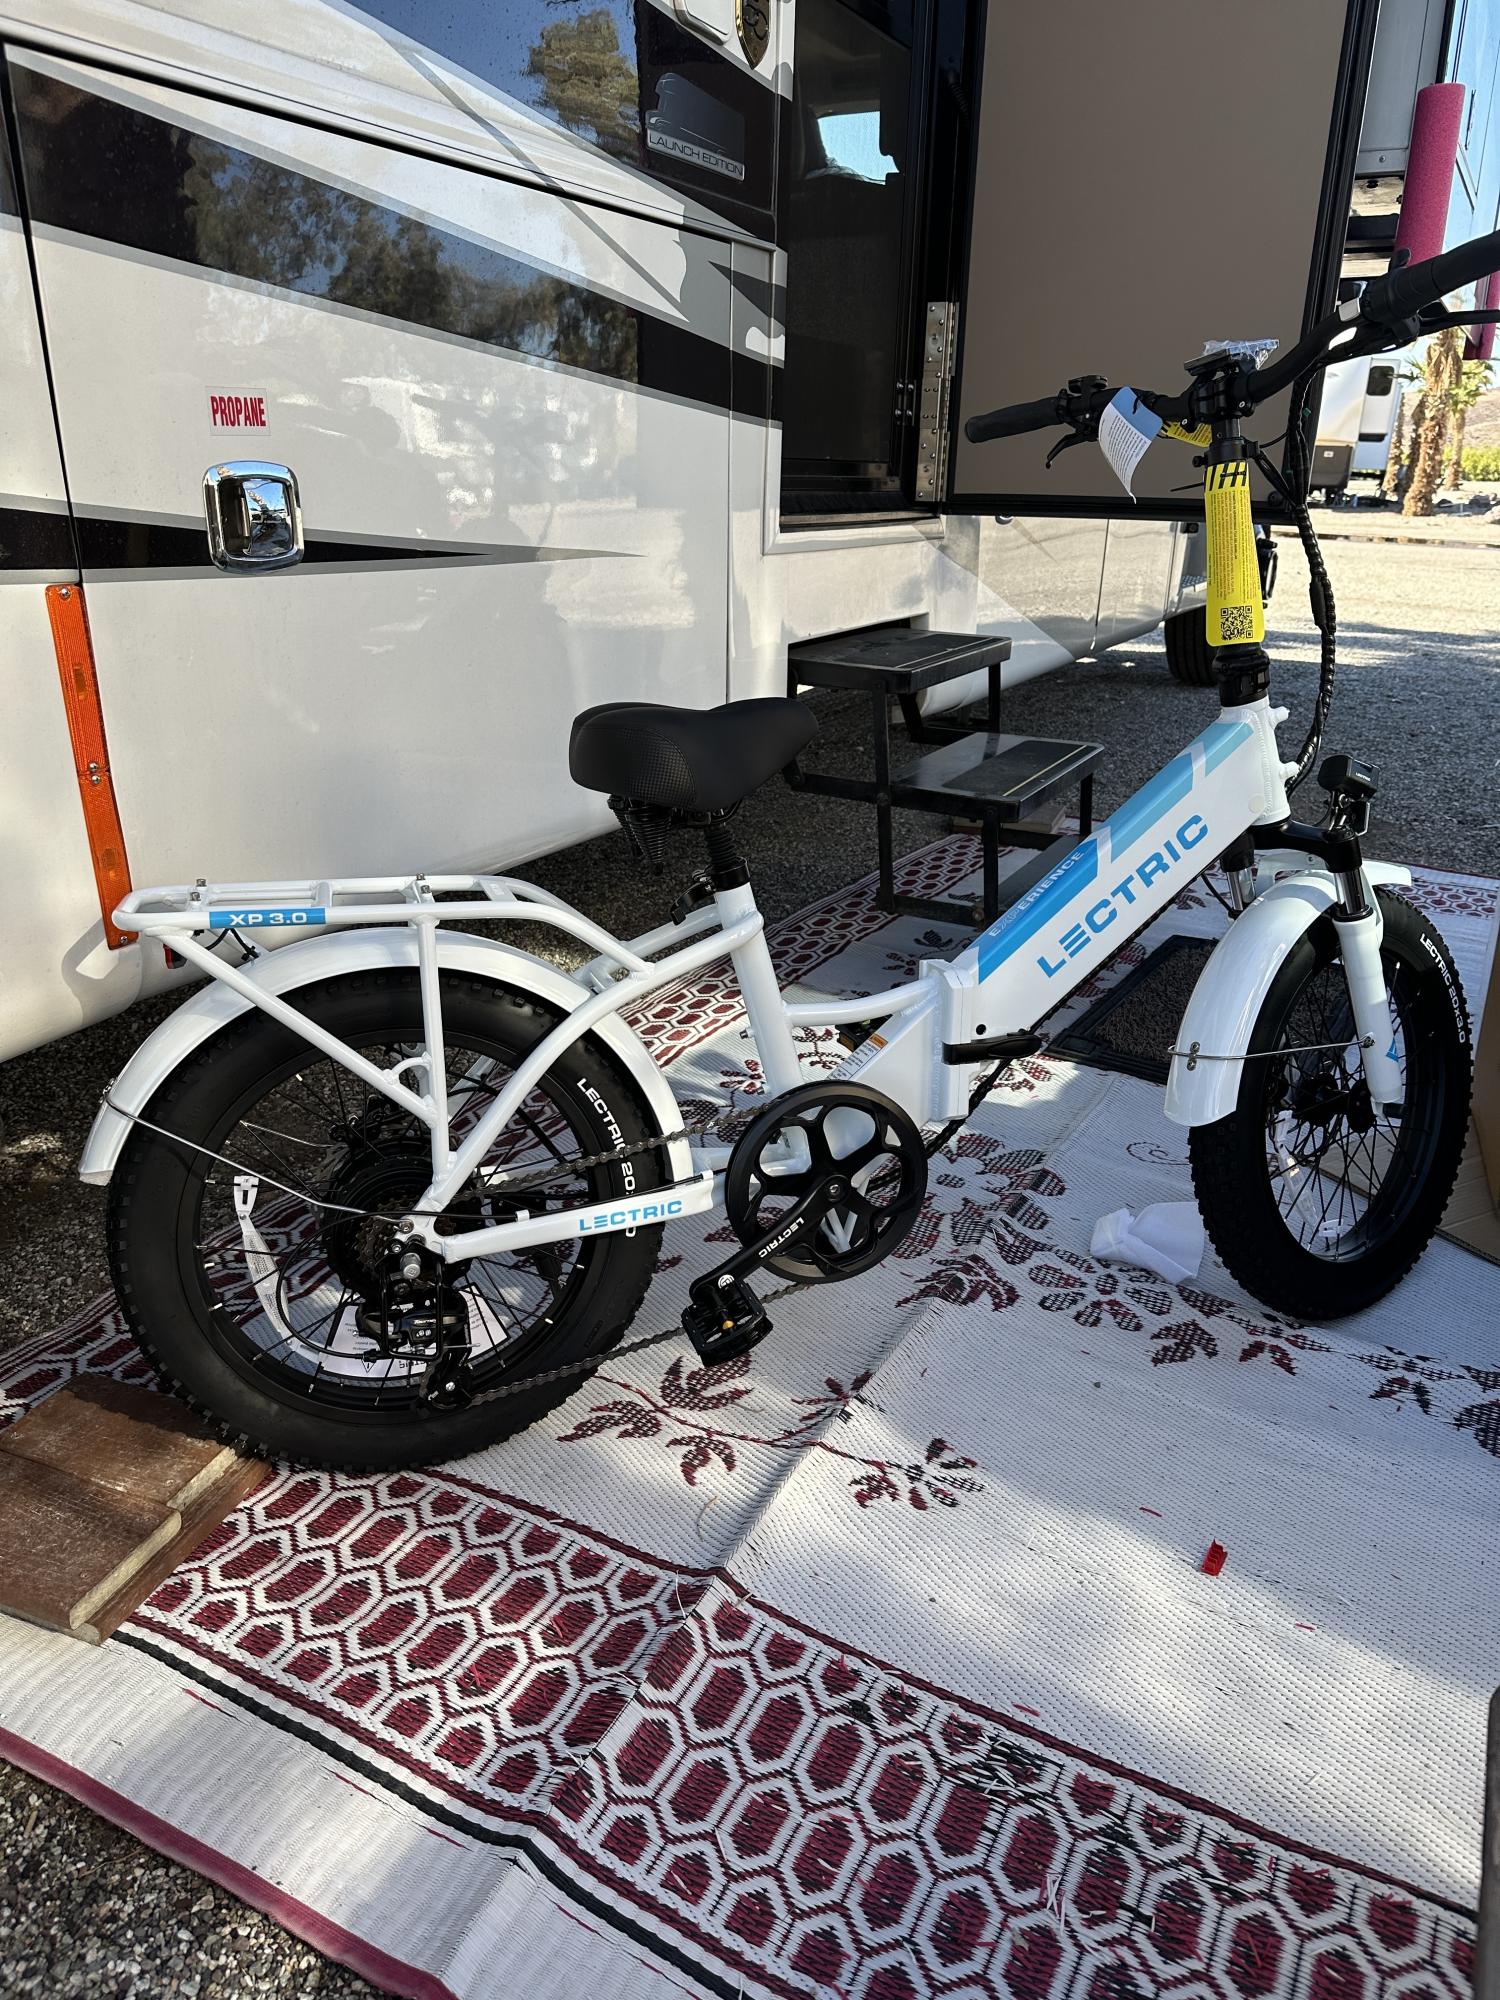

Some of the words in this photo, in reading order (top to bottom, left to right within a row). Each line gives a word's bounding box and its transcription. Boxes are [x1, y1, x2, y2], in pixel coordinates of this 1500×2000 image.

[649, 132, 699, 160] LAUNCH
[702, 153, 743, 176] EDITION
[210, 395, 267, 427] PROPANE
[1036, 813, 1209, 978] LECTRIC
[229, 913, 263, 926] XP
[269, 912, 308, 925] 3.0
[1419, 933, 1452, 986] LECTRIC
[579, 1200, 683, 1232] LECTRIC
[758, 1216, 805, 1259] LECTRIC
